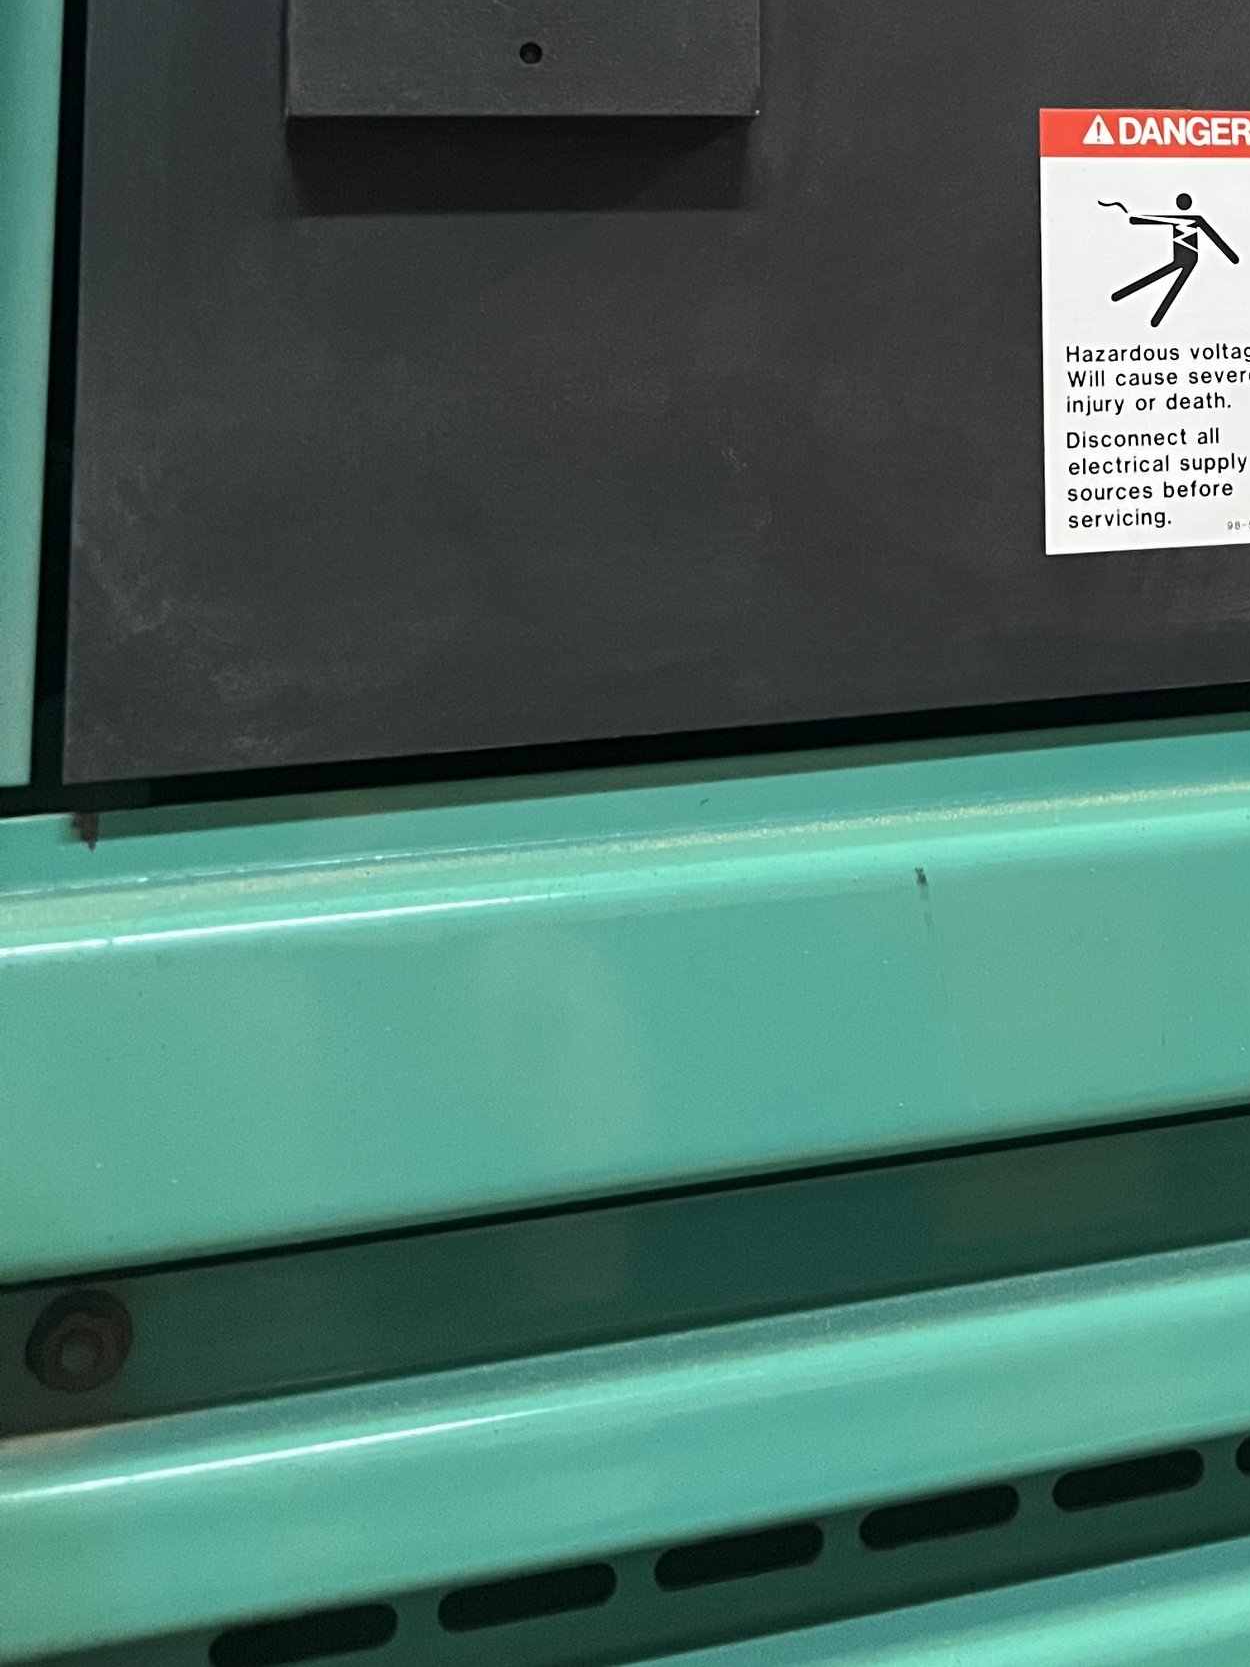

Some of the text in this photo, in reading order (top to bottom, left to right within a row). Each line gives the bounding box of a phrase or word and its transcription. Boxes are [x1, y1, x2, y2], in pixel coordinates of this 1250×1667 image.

[1065, 344, 1180, 363] Hazardous
[1067, 369, 1105, 388] Will
[1115, 371, 1178, 387] cause
[1066, 392, 1231, 416] injury or death.
[1066, 427, 1220, 449] Disconnect all
[1068, 453, 1248, 475] electrical supply
[1067, 480, 1234, 502] sources before
[1068, 508, 1172, 529] servicing.
